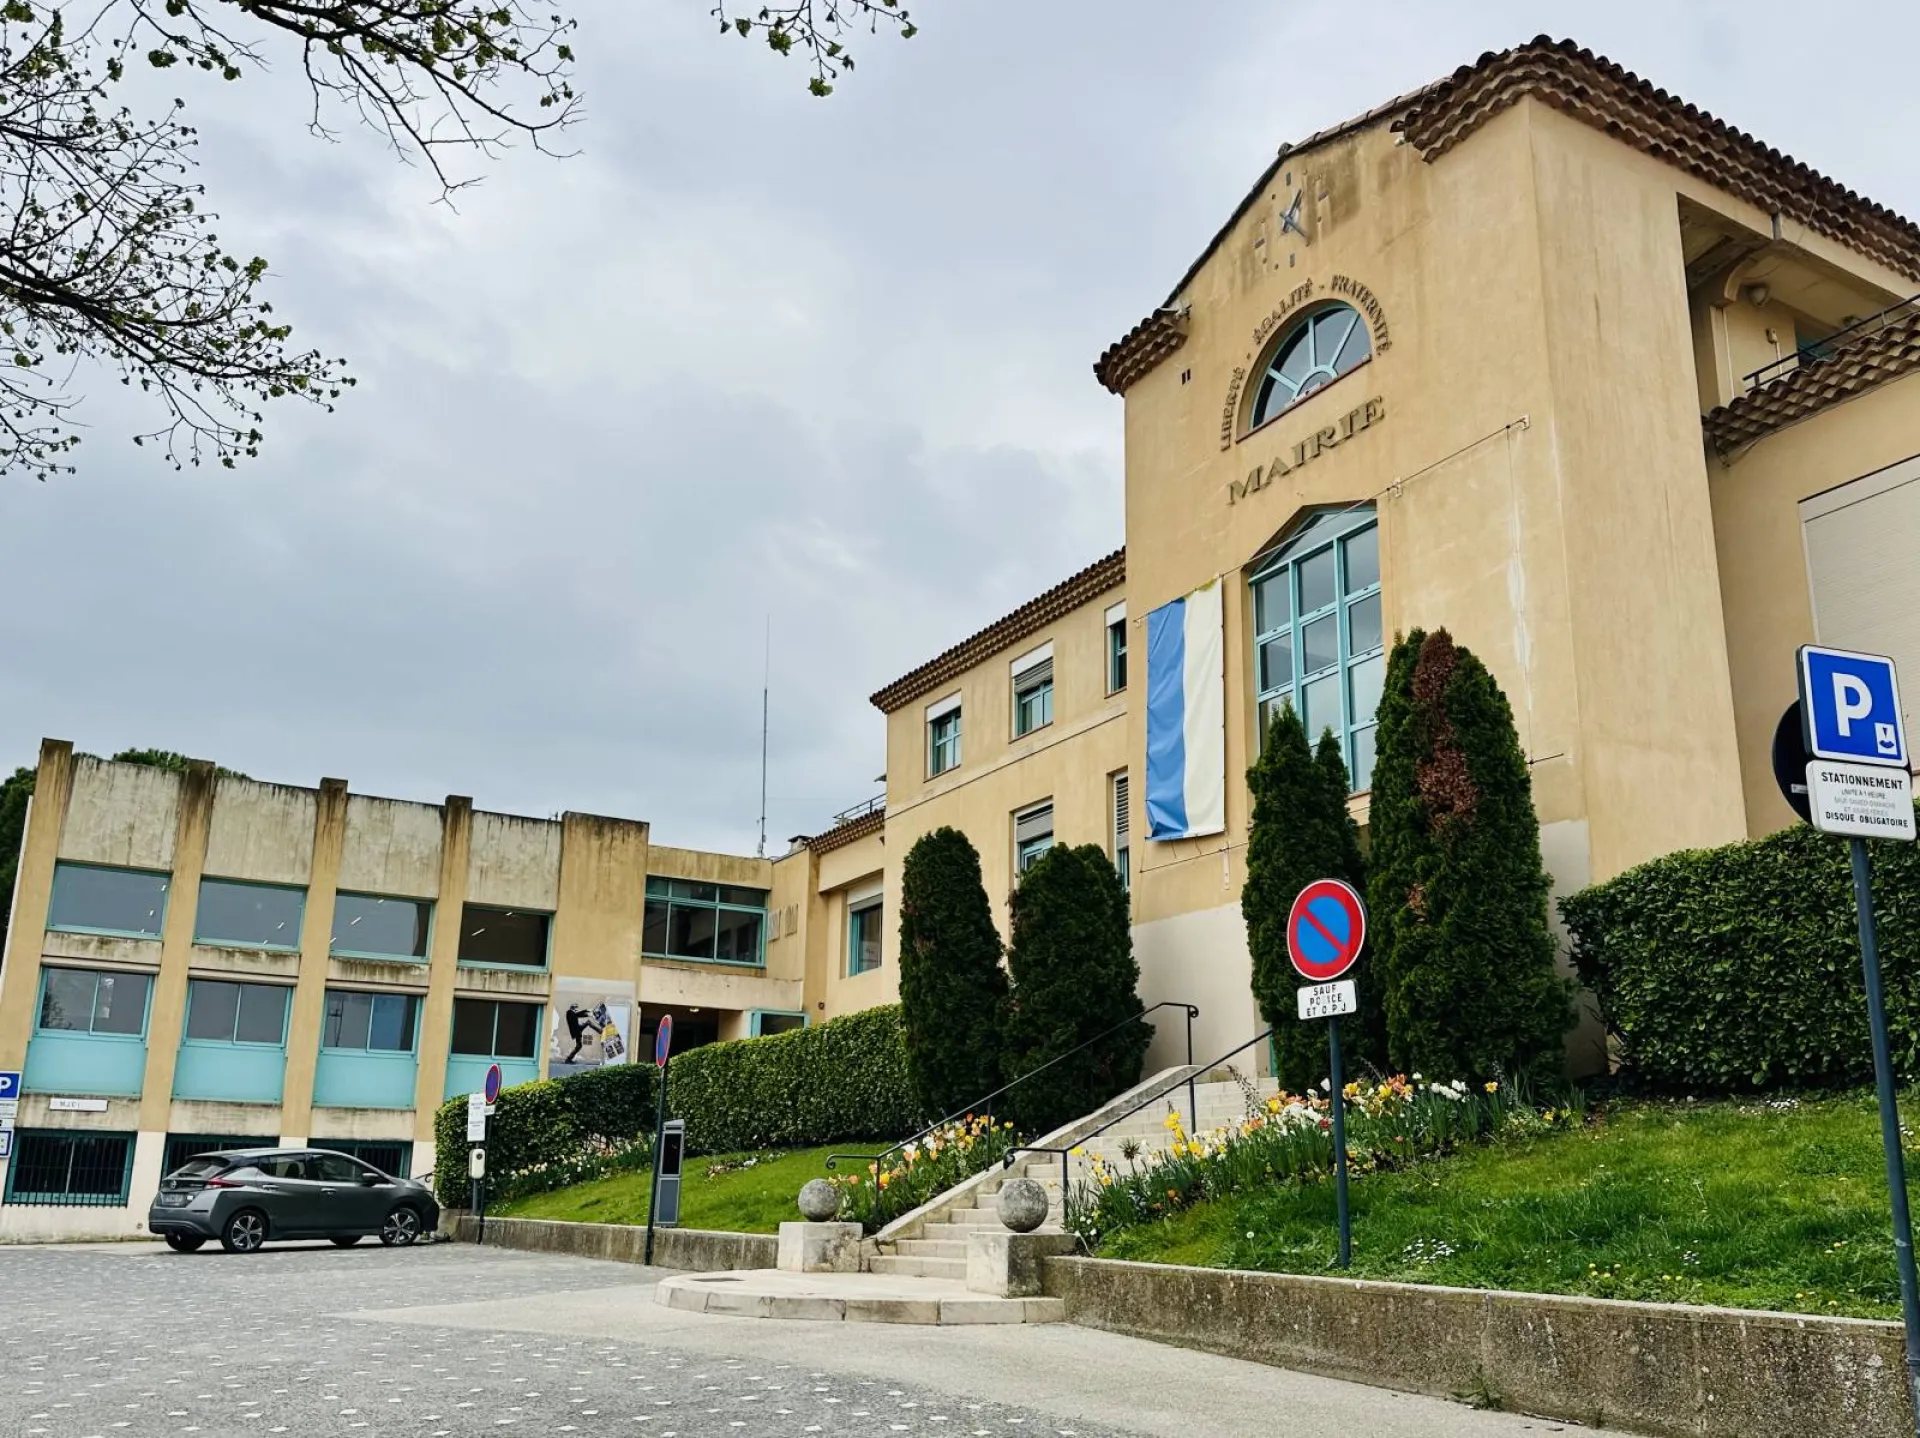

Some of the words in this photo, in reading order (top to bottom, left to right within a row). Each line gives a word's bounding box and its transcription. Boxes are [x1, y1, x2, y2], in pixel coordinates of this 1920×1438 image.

[1227, 395, 1386, 507] MAIRIE
[1832, 672, 1873, 737] P
[1821, 771, 1903, 790] STATIONNEMENT
[1825, 811, 1855, 822] DISQUE
[1860, 815, 1908, 828] OBLIGATOIRE
[1313, 984, 1337, 996] SAUF
[1310, 993, 1342, 1006] POICE
[1307, 1007, 1316, 1017] ET
